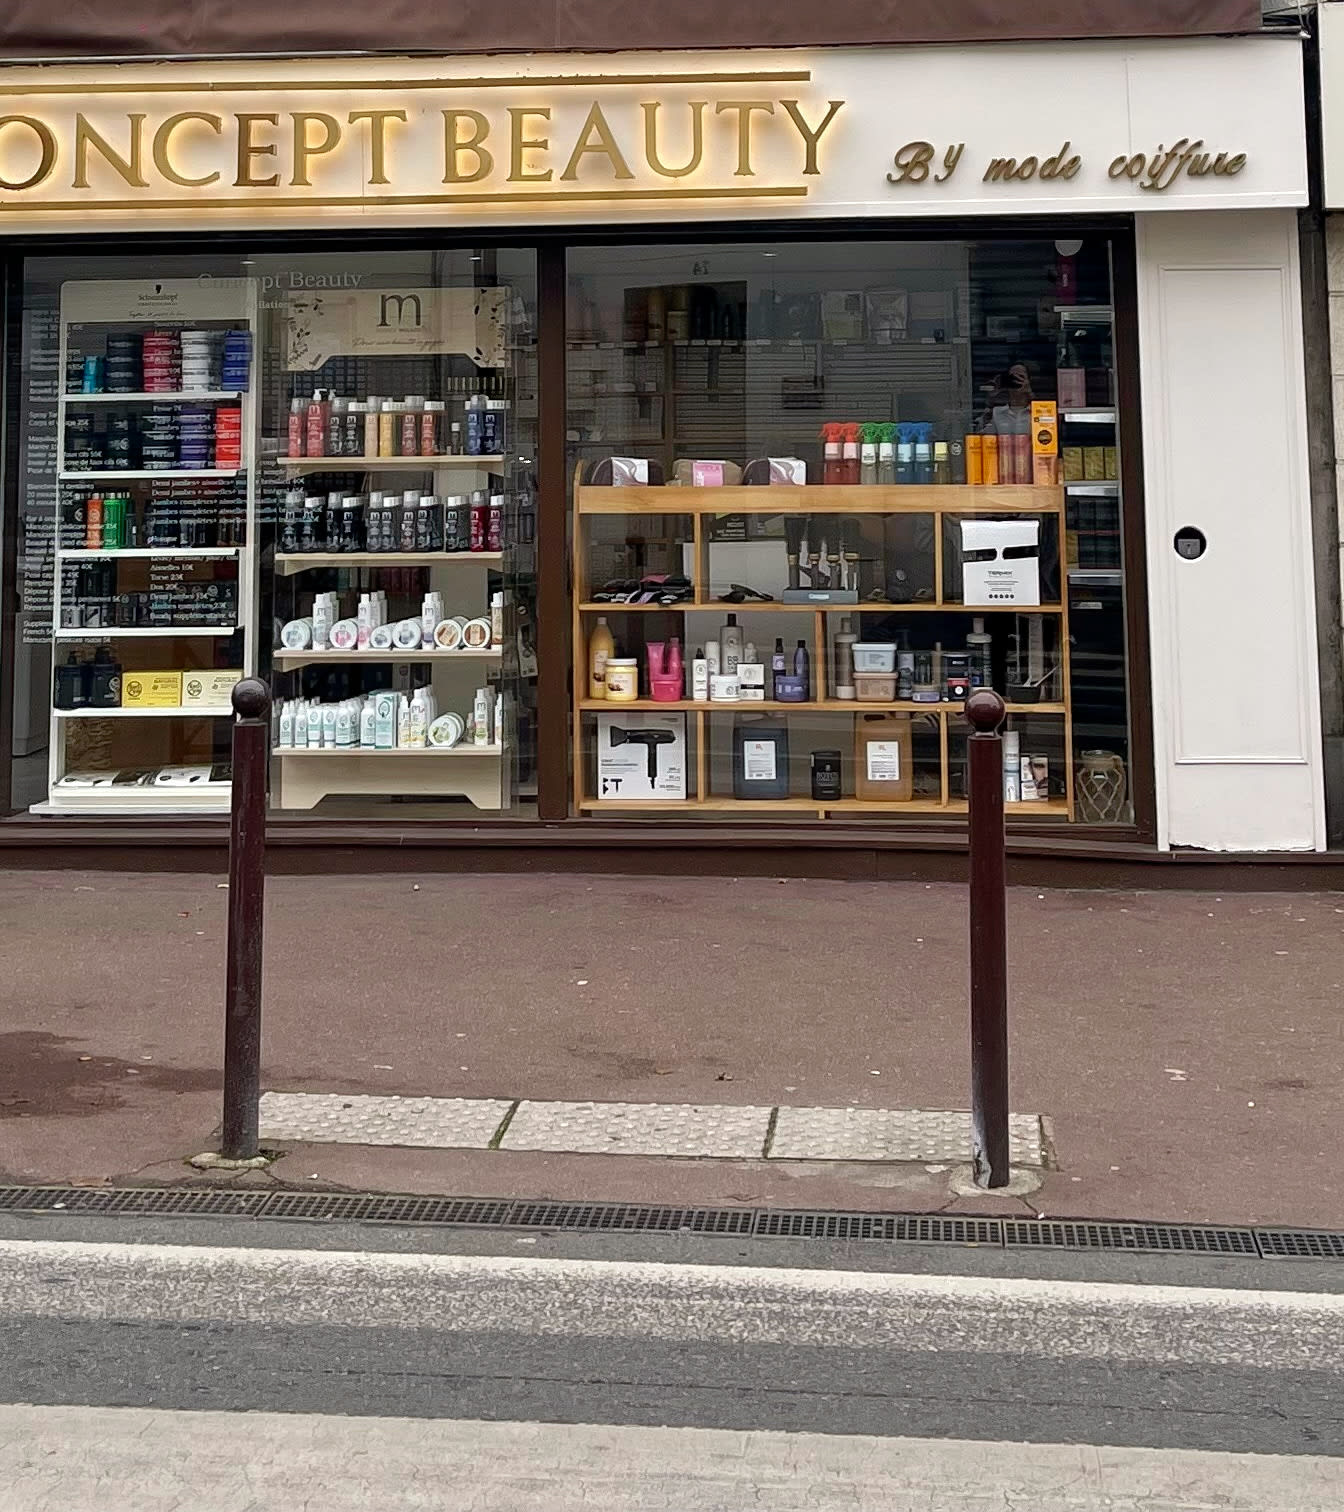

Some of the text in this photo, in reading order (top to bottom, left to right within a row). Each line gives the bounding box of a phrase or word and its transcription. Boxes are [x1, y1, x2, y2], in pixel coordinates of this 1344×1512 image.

[440, 99, 847, 185] BEAUTY
[982, 141, 1083, 183] mode
[1108, 138, 1249, 191] coiffure
[289, 271, 363, 289] Beauty
